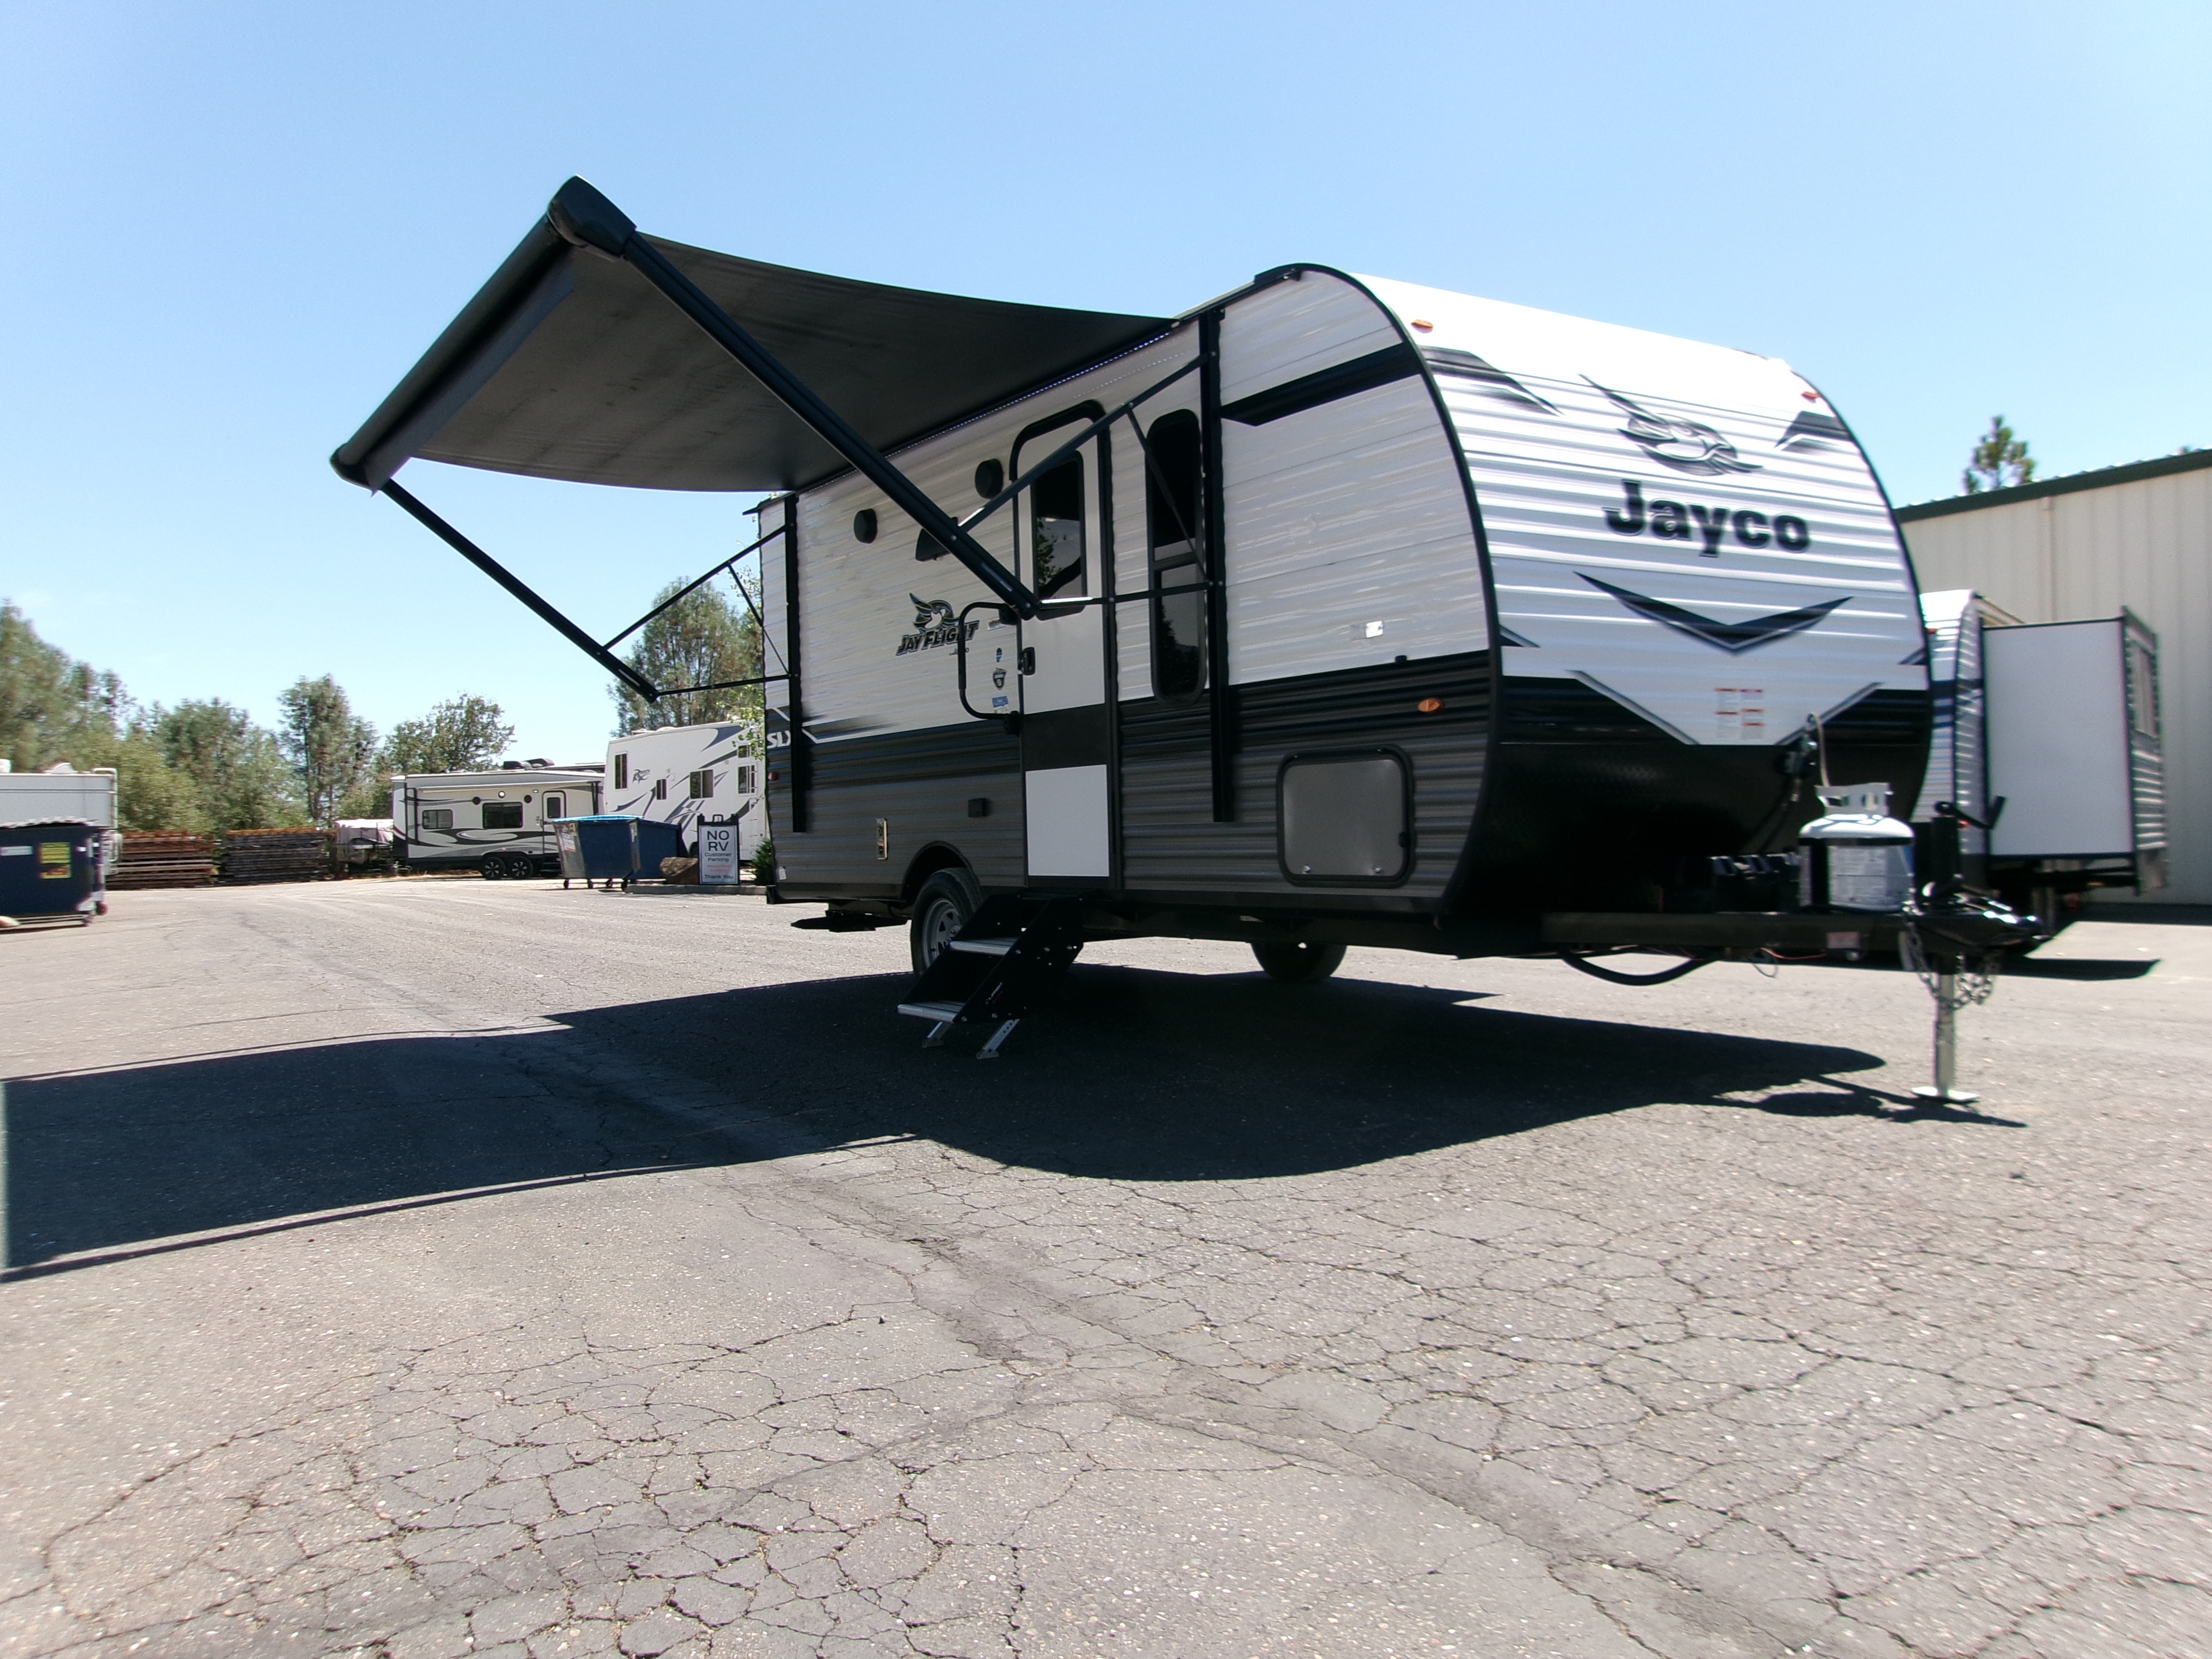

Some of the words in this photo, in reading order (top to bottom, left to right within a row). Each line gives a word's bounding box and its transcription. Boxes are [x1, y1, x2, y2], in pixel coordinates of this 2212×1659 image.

[1601, 479, 1811, 558] Jayco
[895, 634, 924, 656] JAY
[921, 620, 980, 650] FLIGT
[707, 830, 729, 840] NO
[708, 842, 729, 851] RV
